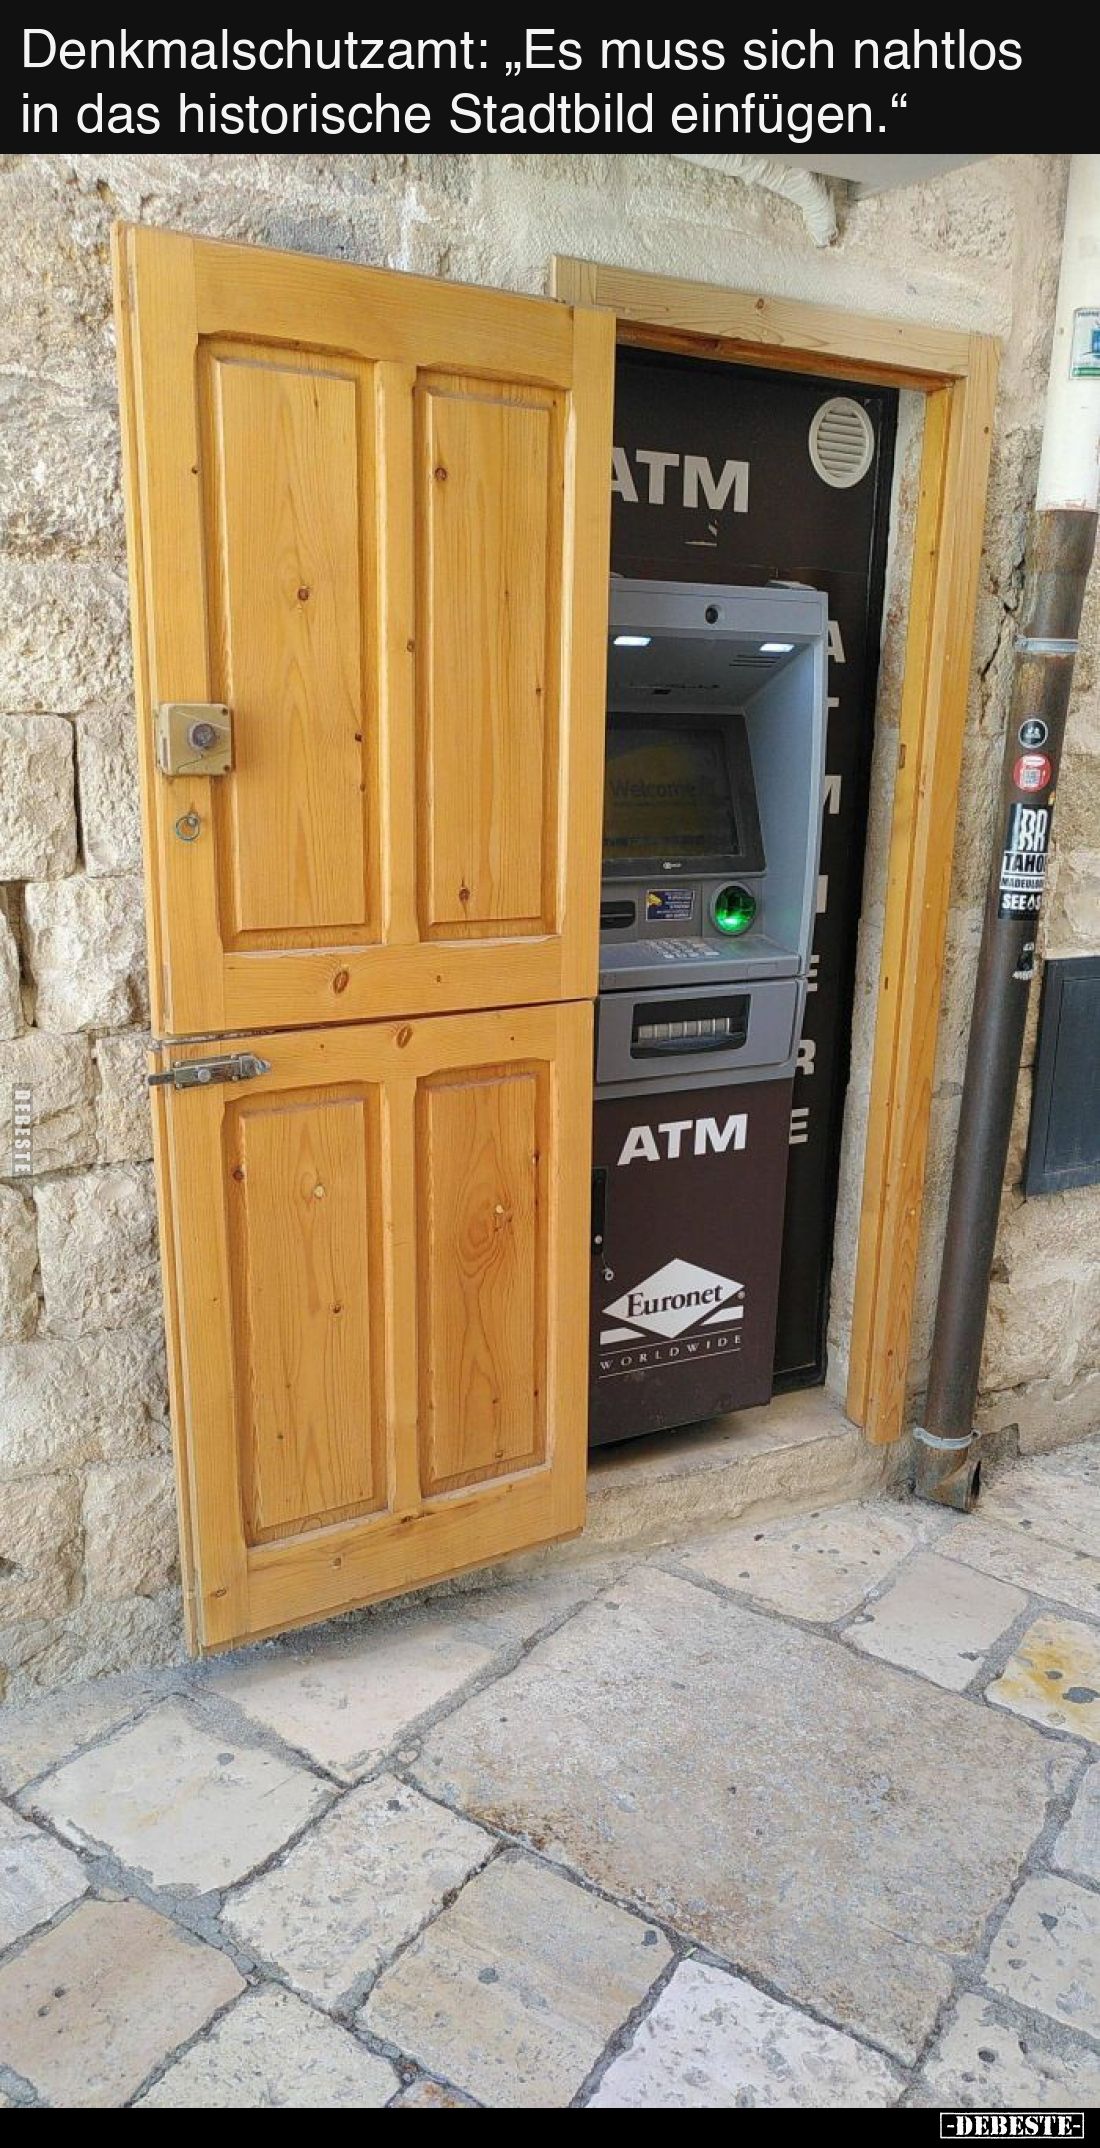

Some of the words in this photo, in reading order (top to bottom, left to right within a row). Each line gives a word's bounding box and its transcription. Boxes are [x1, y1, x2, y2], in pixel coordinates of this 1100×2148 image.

[616, 1113, 749, 1167] ATM
[626, 1284, 724, 1319] Euronet
[600, 1333, 742, 1371] WORLDWIDE
